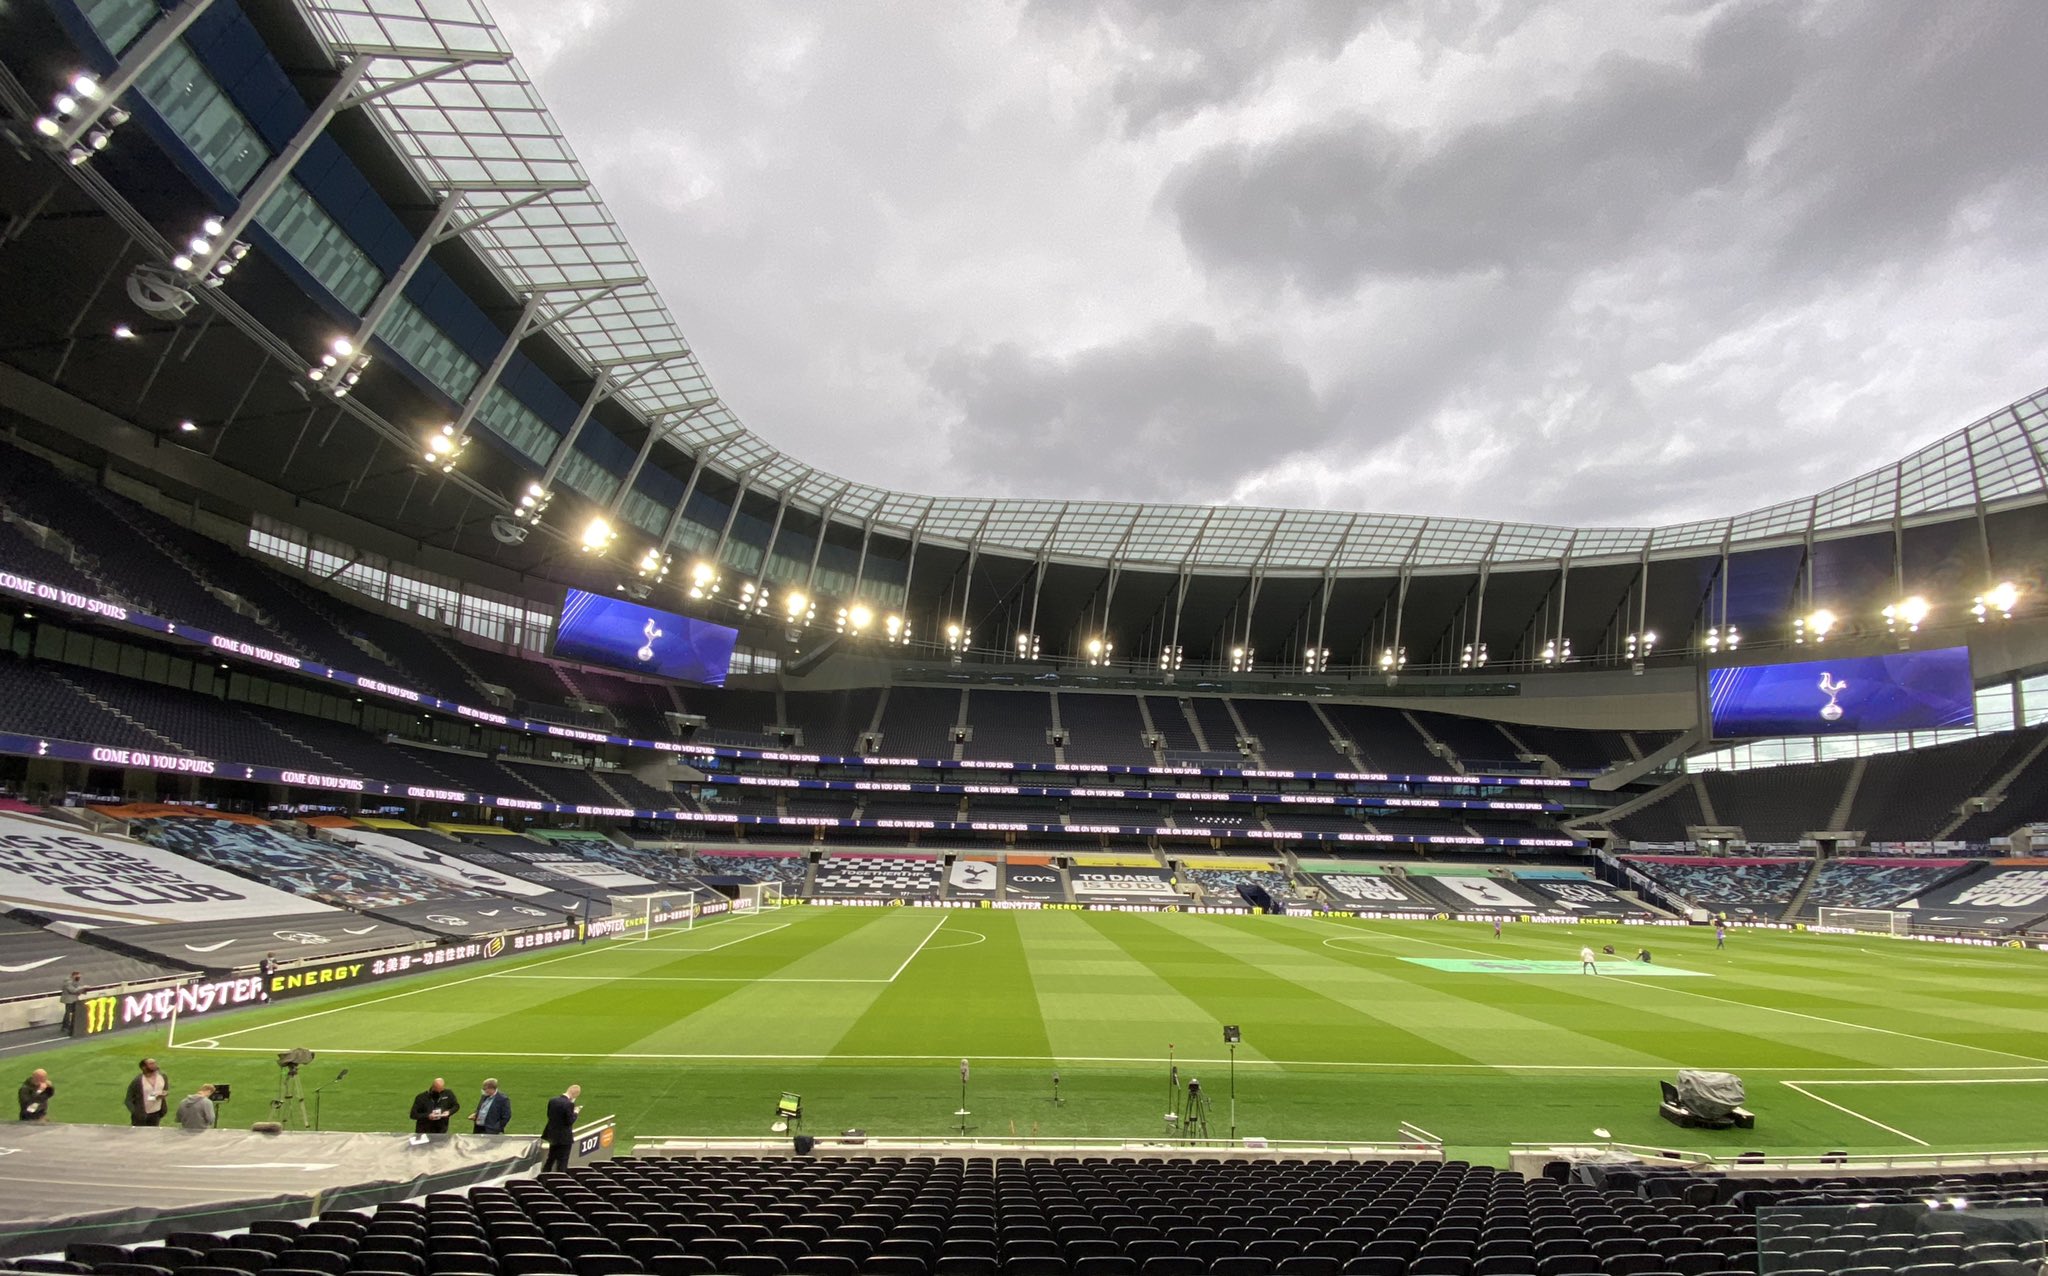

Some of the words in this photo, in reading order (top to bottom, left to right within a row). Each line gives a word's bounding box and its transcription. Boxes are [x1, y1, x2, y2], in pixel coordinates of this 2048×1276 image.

[0, 574, 34, 593] COME
[38, 585, 57, 600] ON
[60, 591, 85, 608] YOU
[88, 600, 126, 619] SPURS
[213, 636, 238, 651] COME
[240, 644, 254, 655] ON
[256, 648, 272, 660] YOU
[274, 653, 300, 668] SPURS
[358, 678, 376, 689] COME
[377, 683, 386, 692] ON
[388, 685, 399, 695] YOU
[400, 689, 418, 700] SPURS
[549, 727, 564, 735] COME
[588, 733, 607, 742] SPURS
[94, 748, 128, 763] COME
[132, 753, 150, 765] ON
[153, 755, 176, 768] YOU
[179, 759, 214, 772] SPURS
[282, 772, 306, 783] COME
[308, 775, 320, 785] ON
[322, 776, 337, 787] YOU
[339, 779, 363, 790] SPURS
[409, 788, 424, 797] COME
[426, 789, 434, 797] ON
[436, 790, 447, 799] YOU
[448, 792, 465, 801] SPURS
[41, 836, 104, 850] IS
[0, 862, 75, 874] MY
[74, 862, 173, 874] ONE
[28, 875, 111, 885] AND
[1109, 874, 1162, 882] DARE
[62, 886, 246, 906] CLUB
[1340, 890, 1408, 900] YOU
[1948, 893, 2047, 907] YOU
[992, 901, 1041, 910] MONSTER
[588, 918, 626, 937] MONSTER
[123, 976, 267, 1023] MONSTER
[271, 964, 361, 991] ENERGY
[582, 1136, 598, 1152] 107
